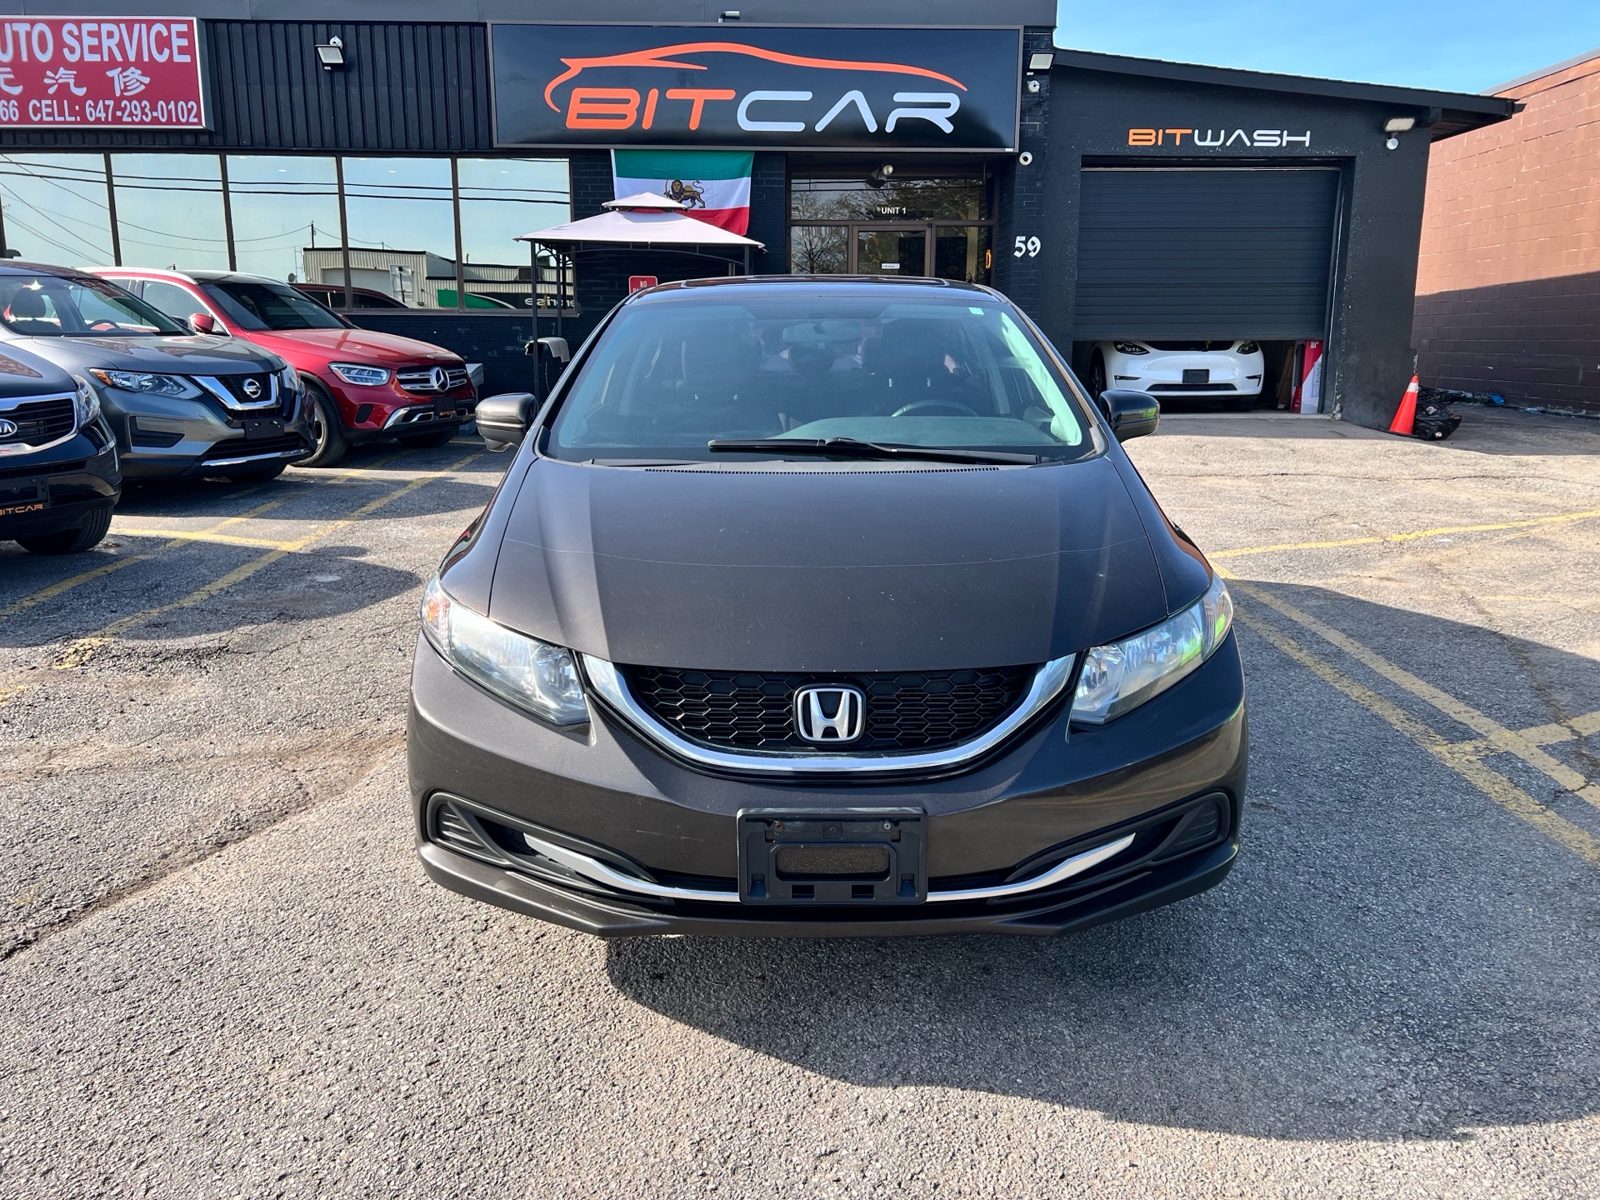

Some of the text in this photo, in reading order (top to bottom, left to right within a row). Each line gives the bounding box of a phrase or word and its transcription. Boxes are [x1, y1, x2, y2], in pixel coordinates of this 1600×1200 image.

[61, 22, 191, 63] SERVICE
[28, 99, 81, 121] CELL:
[85, 99, 199, 123] 647-293-0102
[565, 87, 961, 134] BITCAR
[1127, 128, 1311, 148] BITWASH
[881, 206, 906, 215] UNIT 1
[1013, 235, 1042, 258] 59
[0, 503, 44, 516] ITCAR
